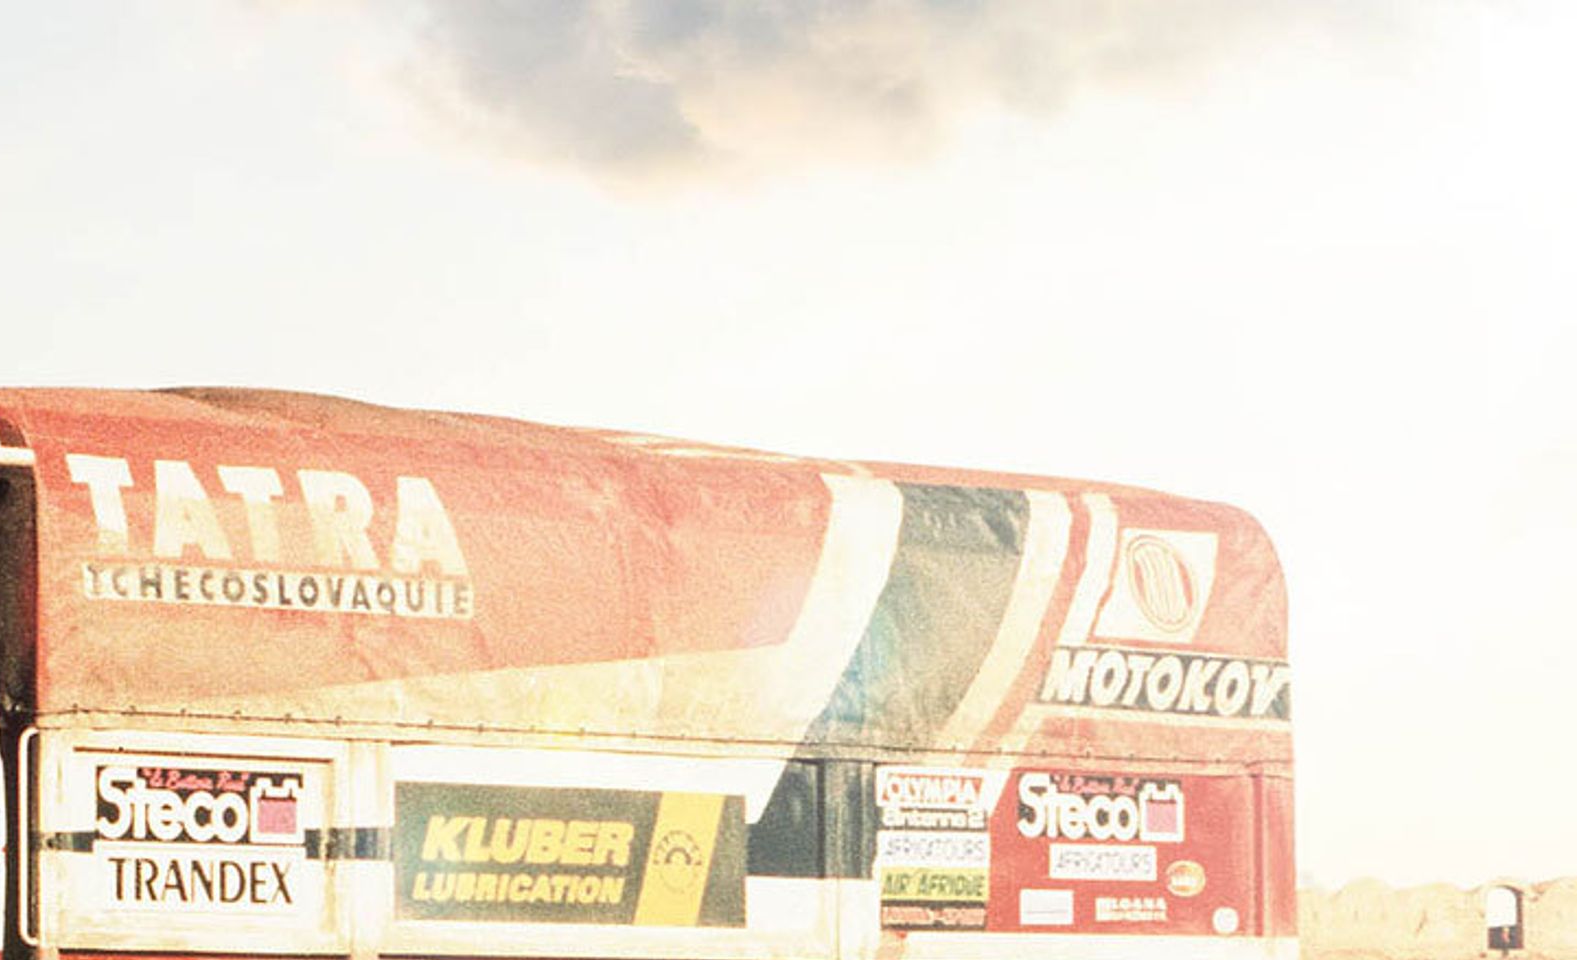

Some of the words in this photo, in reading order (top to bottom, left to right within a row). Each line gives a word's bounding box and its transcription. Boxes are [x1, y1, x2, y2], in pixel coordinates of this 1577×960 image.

[65, 453, 470, 576] TATRA
[87, 564, 470, 616] TCHECOSLOVAQUIE
[97, 766, 249, 843] Steco
[887, 775, 980, 804] OLYMPIA
[1017, 773, 1139, 841] Steco
[420, 814, 636, 866] KLUBER
[107, 857, 293, 904] TRANDEX
[411, 871, 624, 905] LUBRICATION
[882, 873, 911, 895] AIR
[916, 874, 986, 898] AFRIQUE
